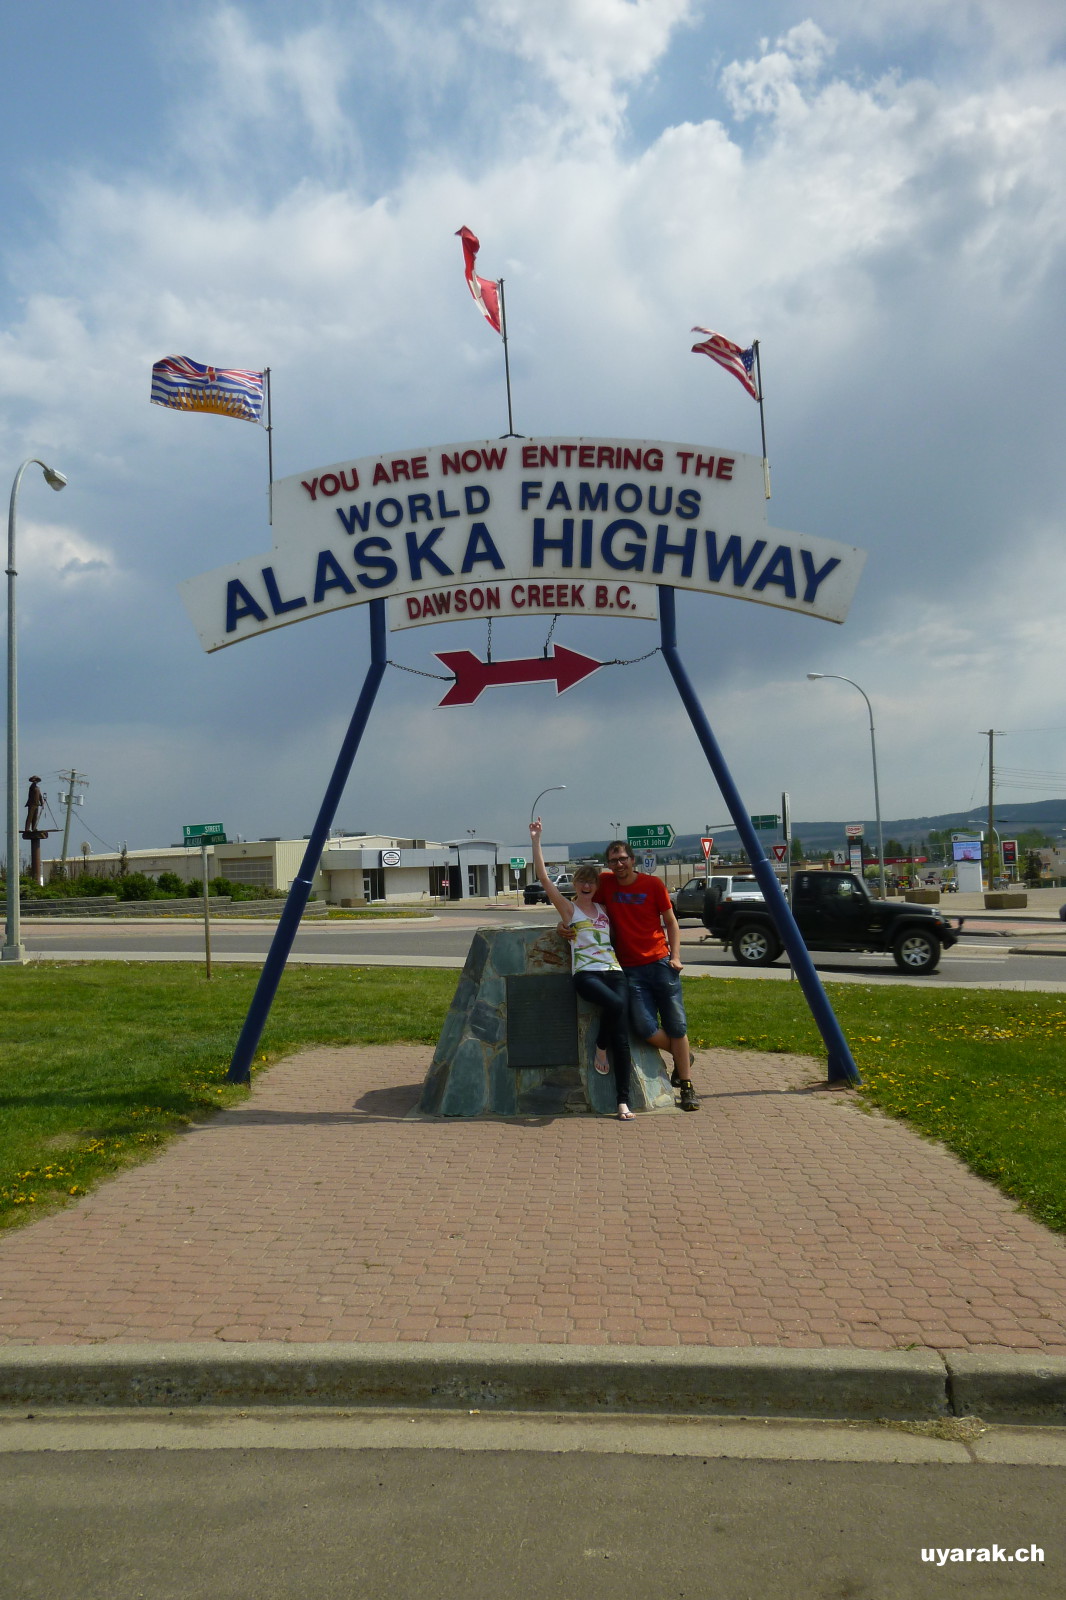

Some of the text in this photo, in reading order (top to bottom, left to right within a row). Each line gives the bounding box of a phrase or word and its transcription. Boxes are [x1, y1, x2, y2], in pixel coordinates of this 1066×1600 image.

[301, 445, 735, 500] YOU ARE NOW ENTERING THE
[336, 481, 701, 536] WORLD FAMOUS
[224, 517, 841, 633] ALASKA HIGHWAY
[406, 584, 637, 620] DAWSON CREEK B.C.
[204, 825, 221, 833] STREET
[644, 858, 654, 867] 97
